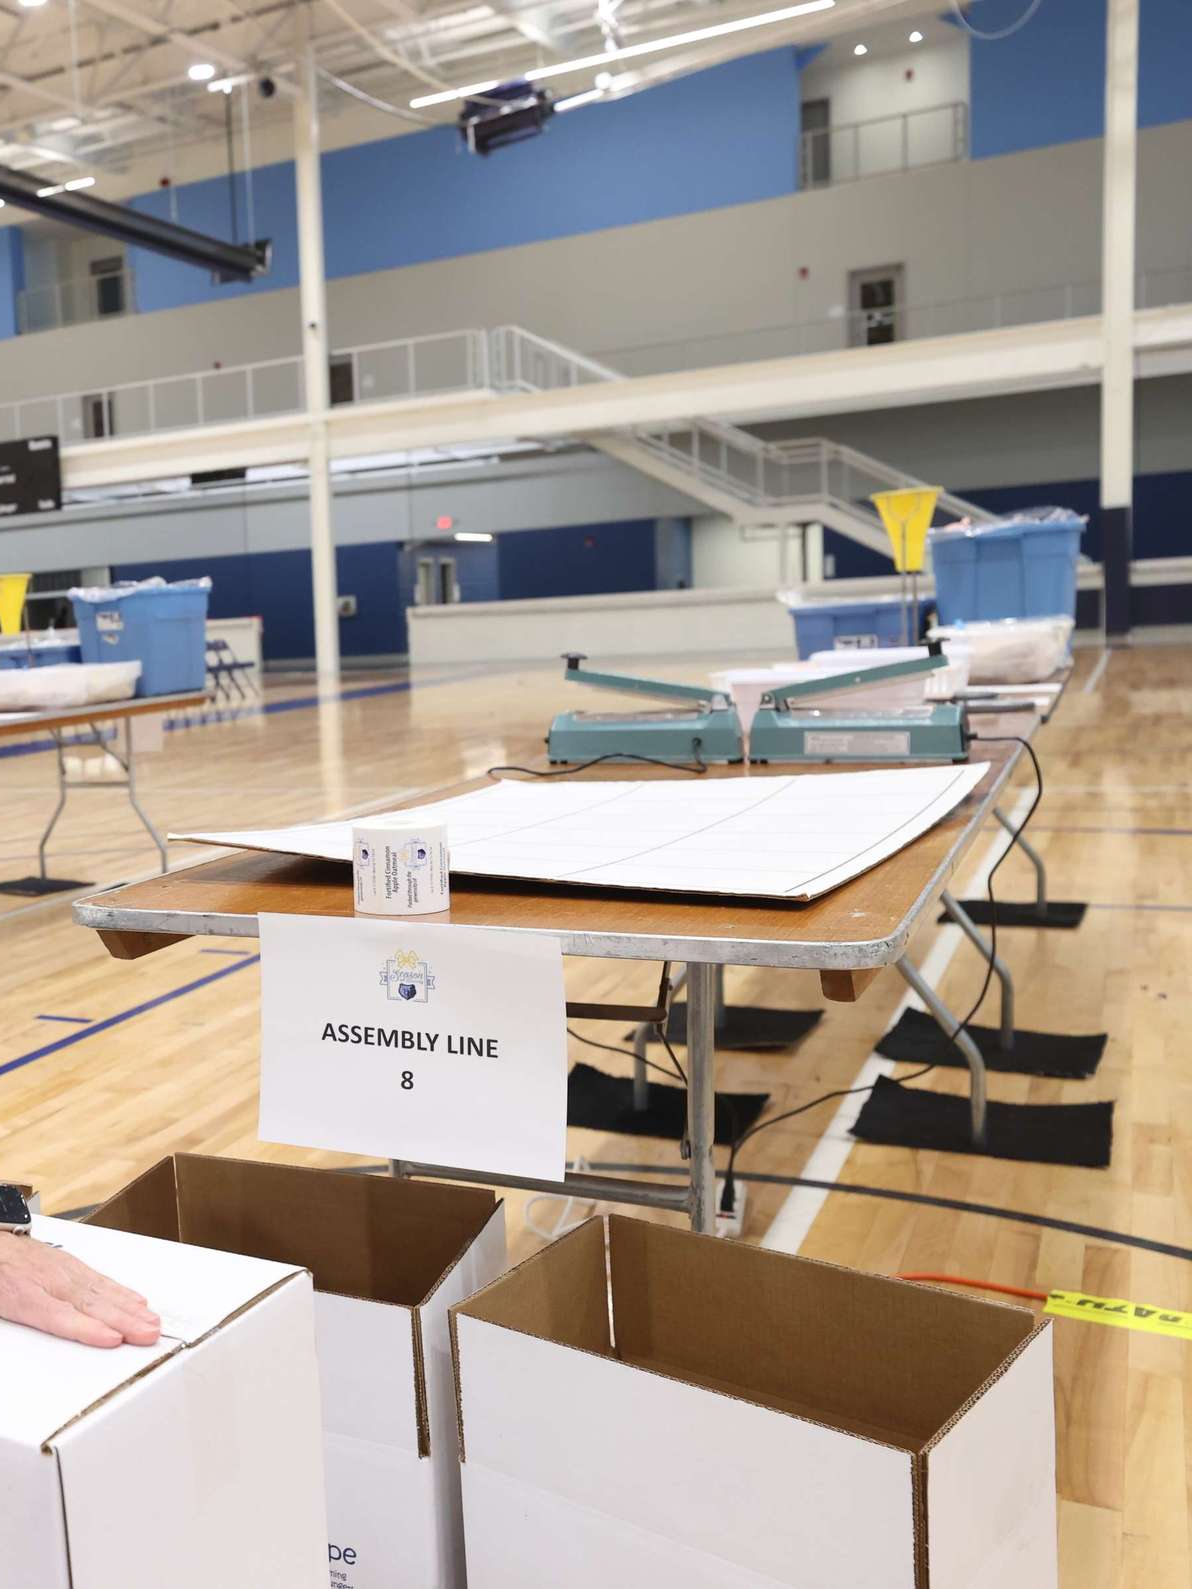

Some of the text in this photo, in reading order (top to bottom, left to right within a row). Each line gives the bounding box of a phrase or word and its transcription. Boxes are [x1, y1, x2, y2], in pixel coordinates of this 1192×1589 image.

[321, 1022, 499, 1059] ASSEMBLY LINE
[400, 1070, 414, 1090] 8
